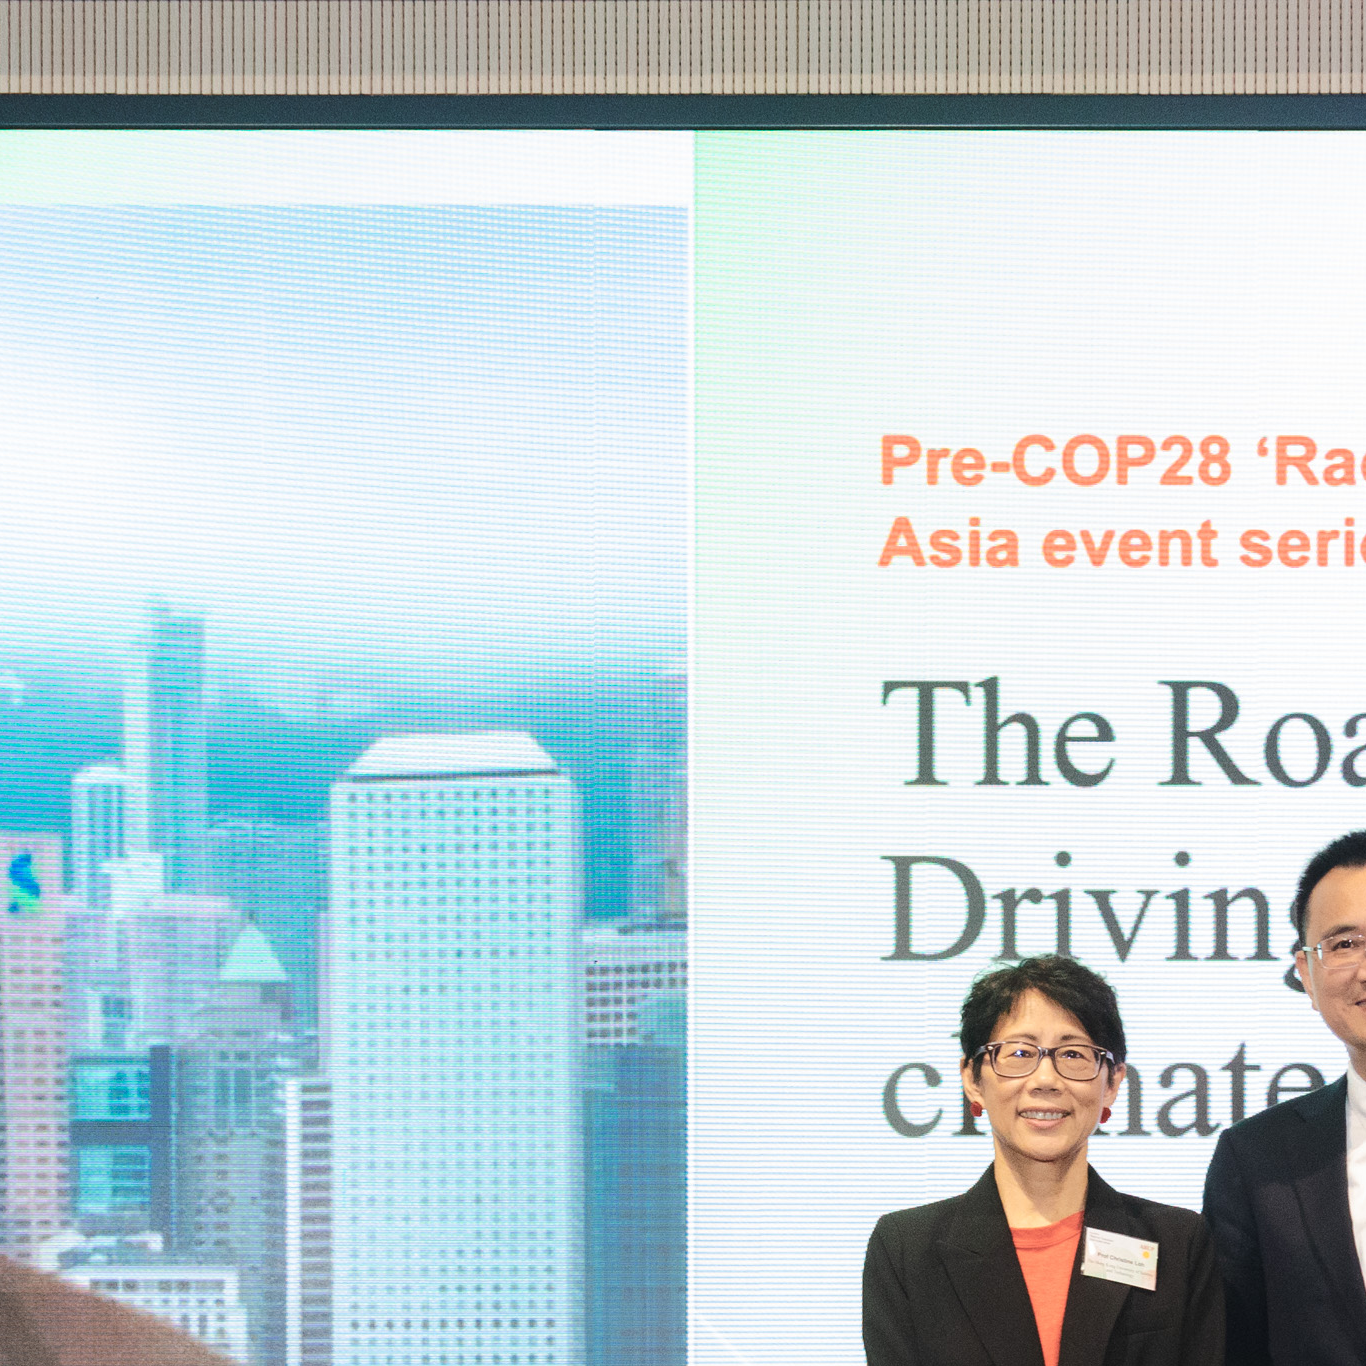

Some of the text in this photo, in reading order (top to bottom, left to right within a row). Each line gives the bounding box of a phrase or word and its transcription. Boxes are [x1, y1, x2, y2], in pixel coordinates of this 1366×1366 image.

[880, 433, 1232, 488] Pre-COP28
[878, 516, 1019, 569] Asia
[1042, 520, 1219, 569] event
[882, 676, 1115, 788] The
[883, 852, 1307, 992] Drivin
